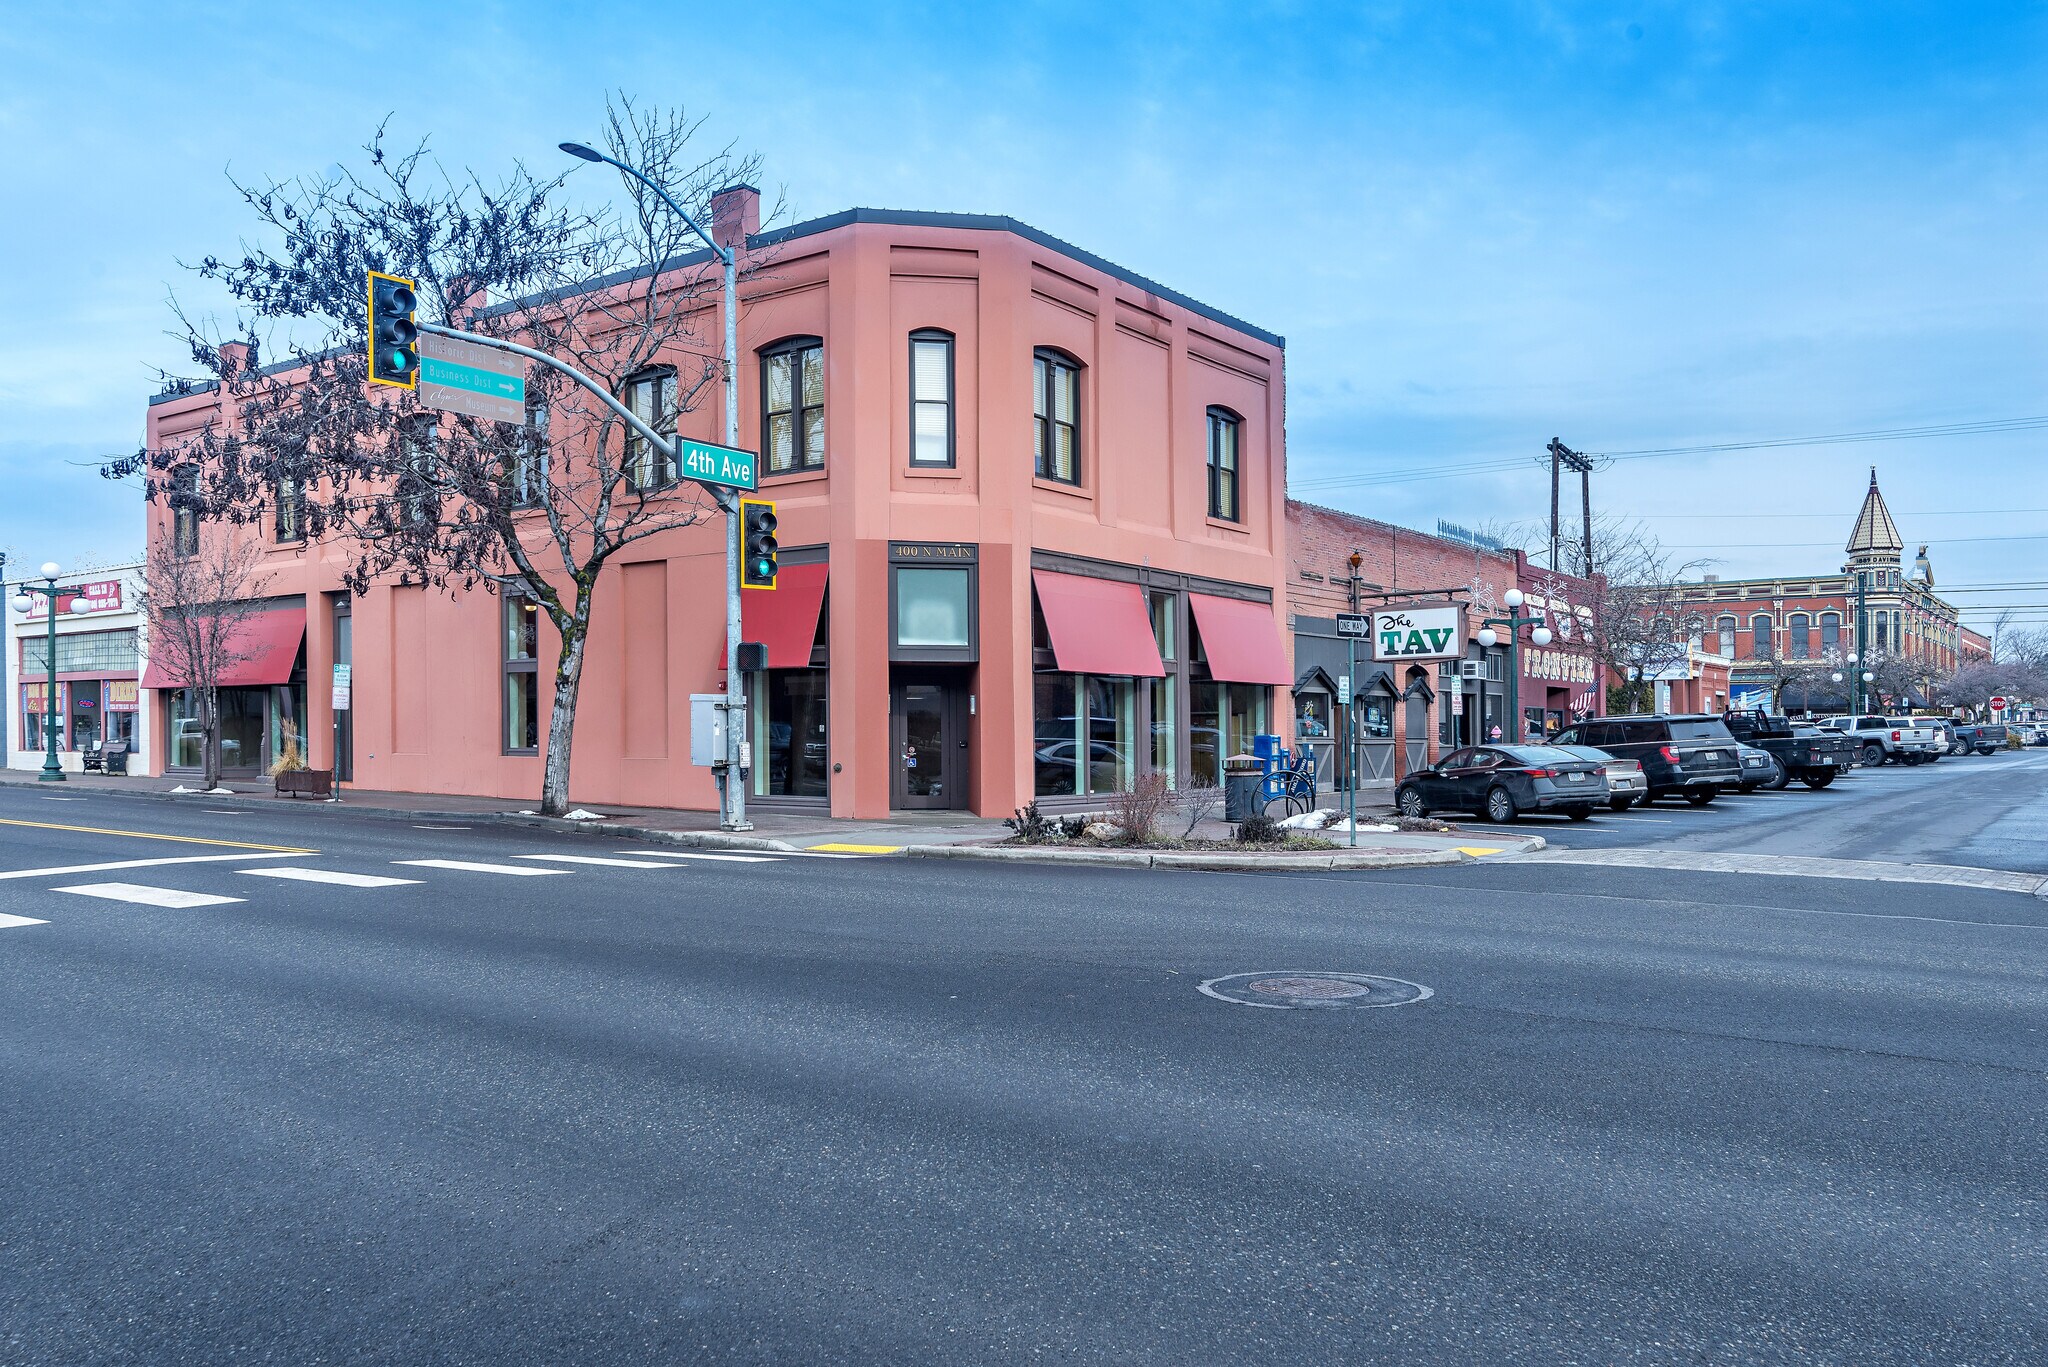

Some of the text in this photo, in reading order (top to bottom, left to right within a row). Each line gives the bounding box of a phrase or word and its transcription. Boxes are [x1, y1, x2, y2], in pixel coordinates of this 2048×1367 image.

[429, 341, 486, 365] Historic Dist
[429, 364, 491, 388] Business Dist
[465, 397, 496, 412] Museum
[686, 449, 750, 482] 4th Ave
[895, 546, 971, 558] 400 N MAIN
[1339, 620, 1364, 631] ONE WAY
[1377, 613, 1415, 631] The
[1380, 628, 1454, 656] TAV
[1523, 647, 1595, 684] FRONTIER
